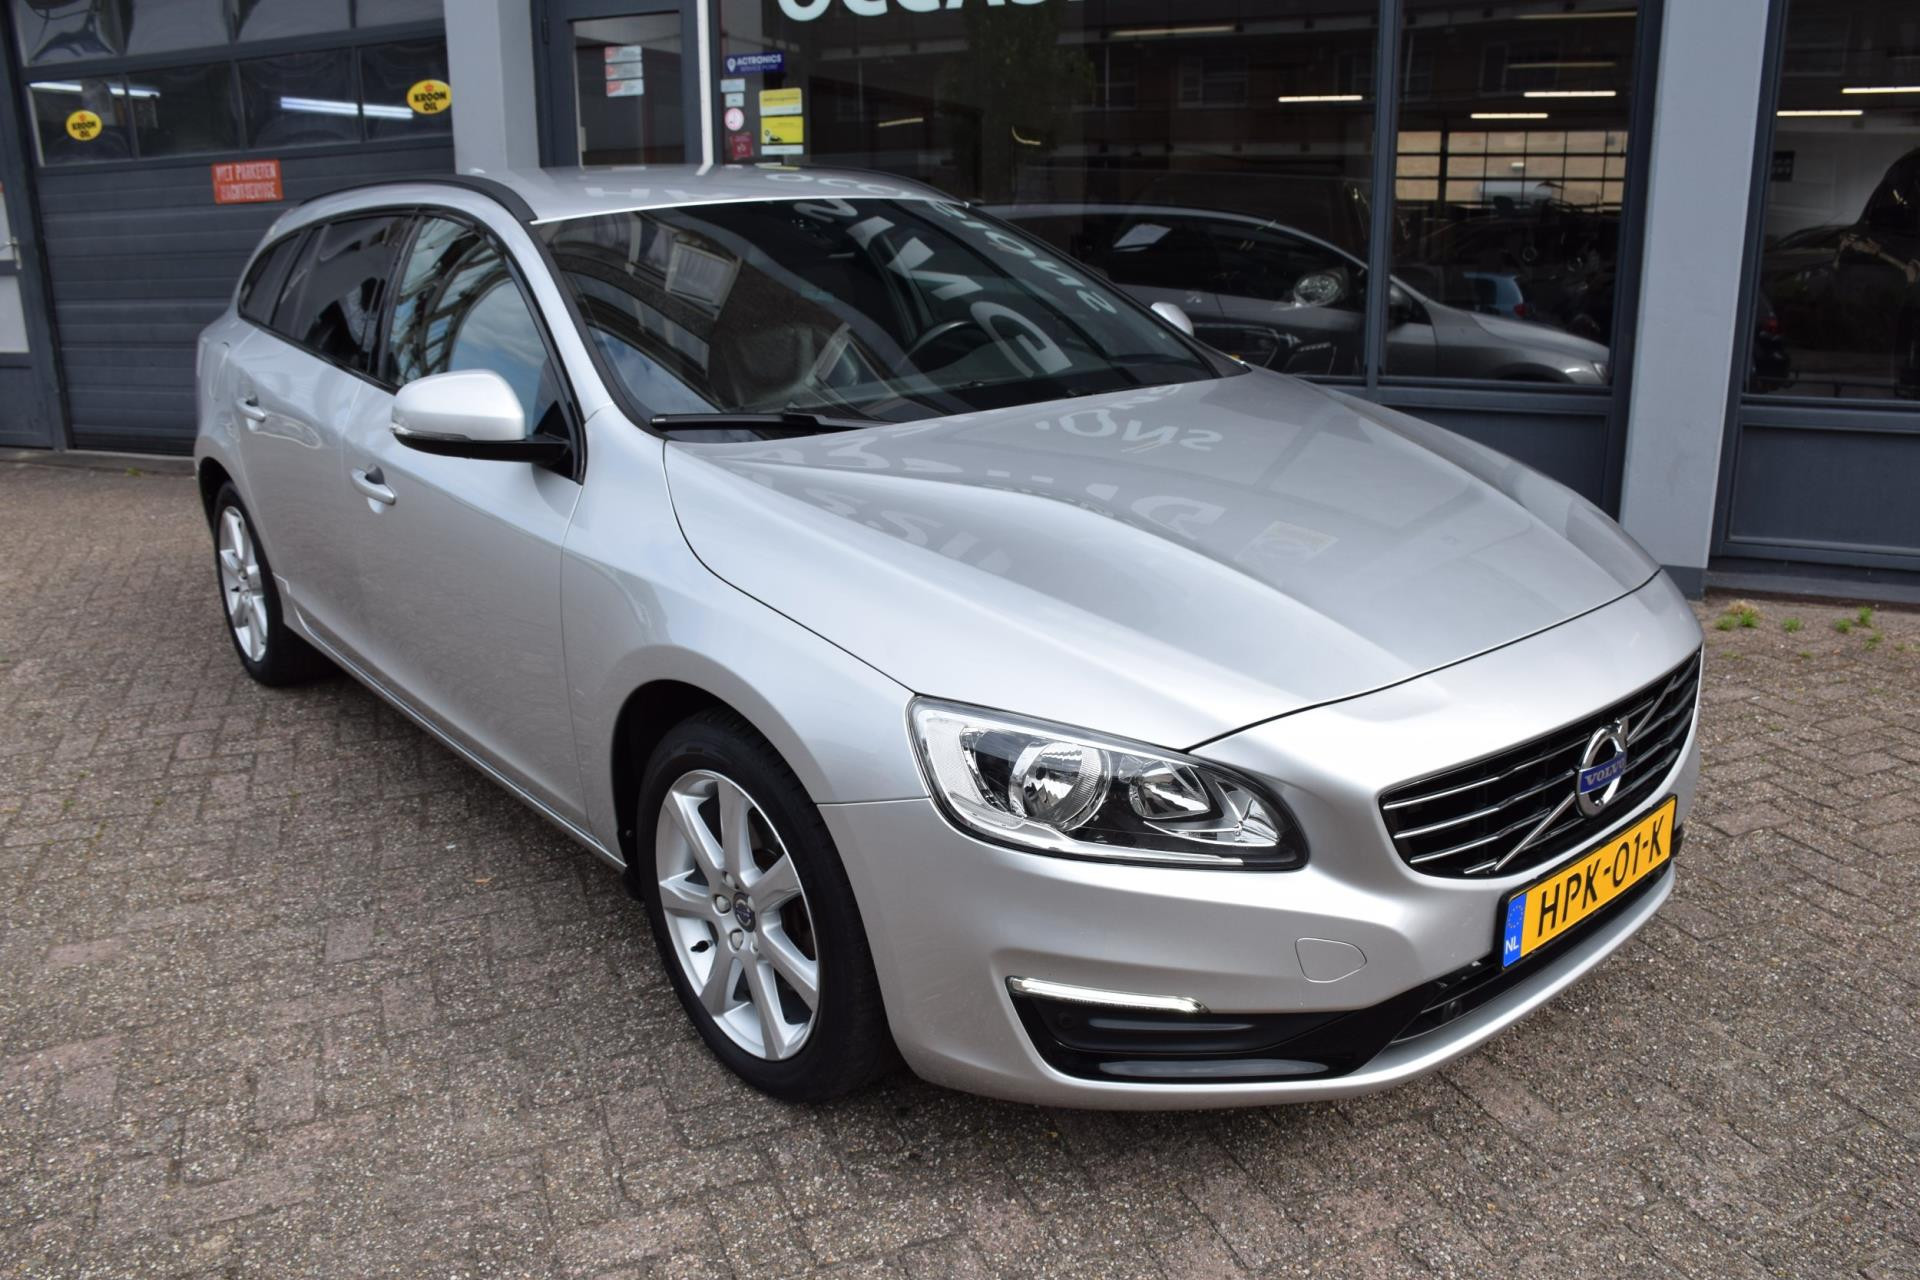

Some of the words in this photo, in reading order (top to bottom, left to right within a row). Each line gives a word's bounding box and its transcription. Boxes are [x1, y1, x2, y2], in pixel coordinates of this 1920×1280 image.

[737, 54, 782, 66] ACTRONICS
[414, 92, 447, 102] KROON
[423, 102, 438, 111] OIL
[1584, 757, 1626, 786] VOLVO
[1537, 814, 1665, 938] HPK-01-K
[1504, 935, 1520, 955] NL
